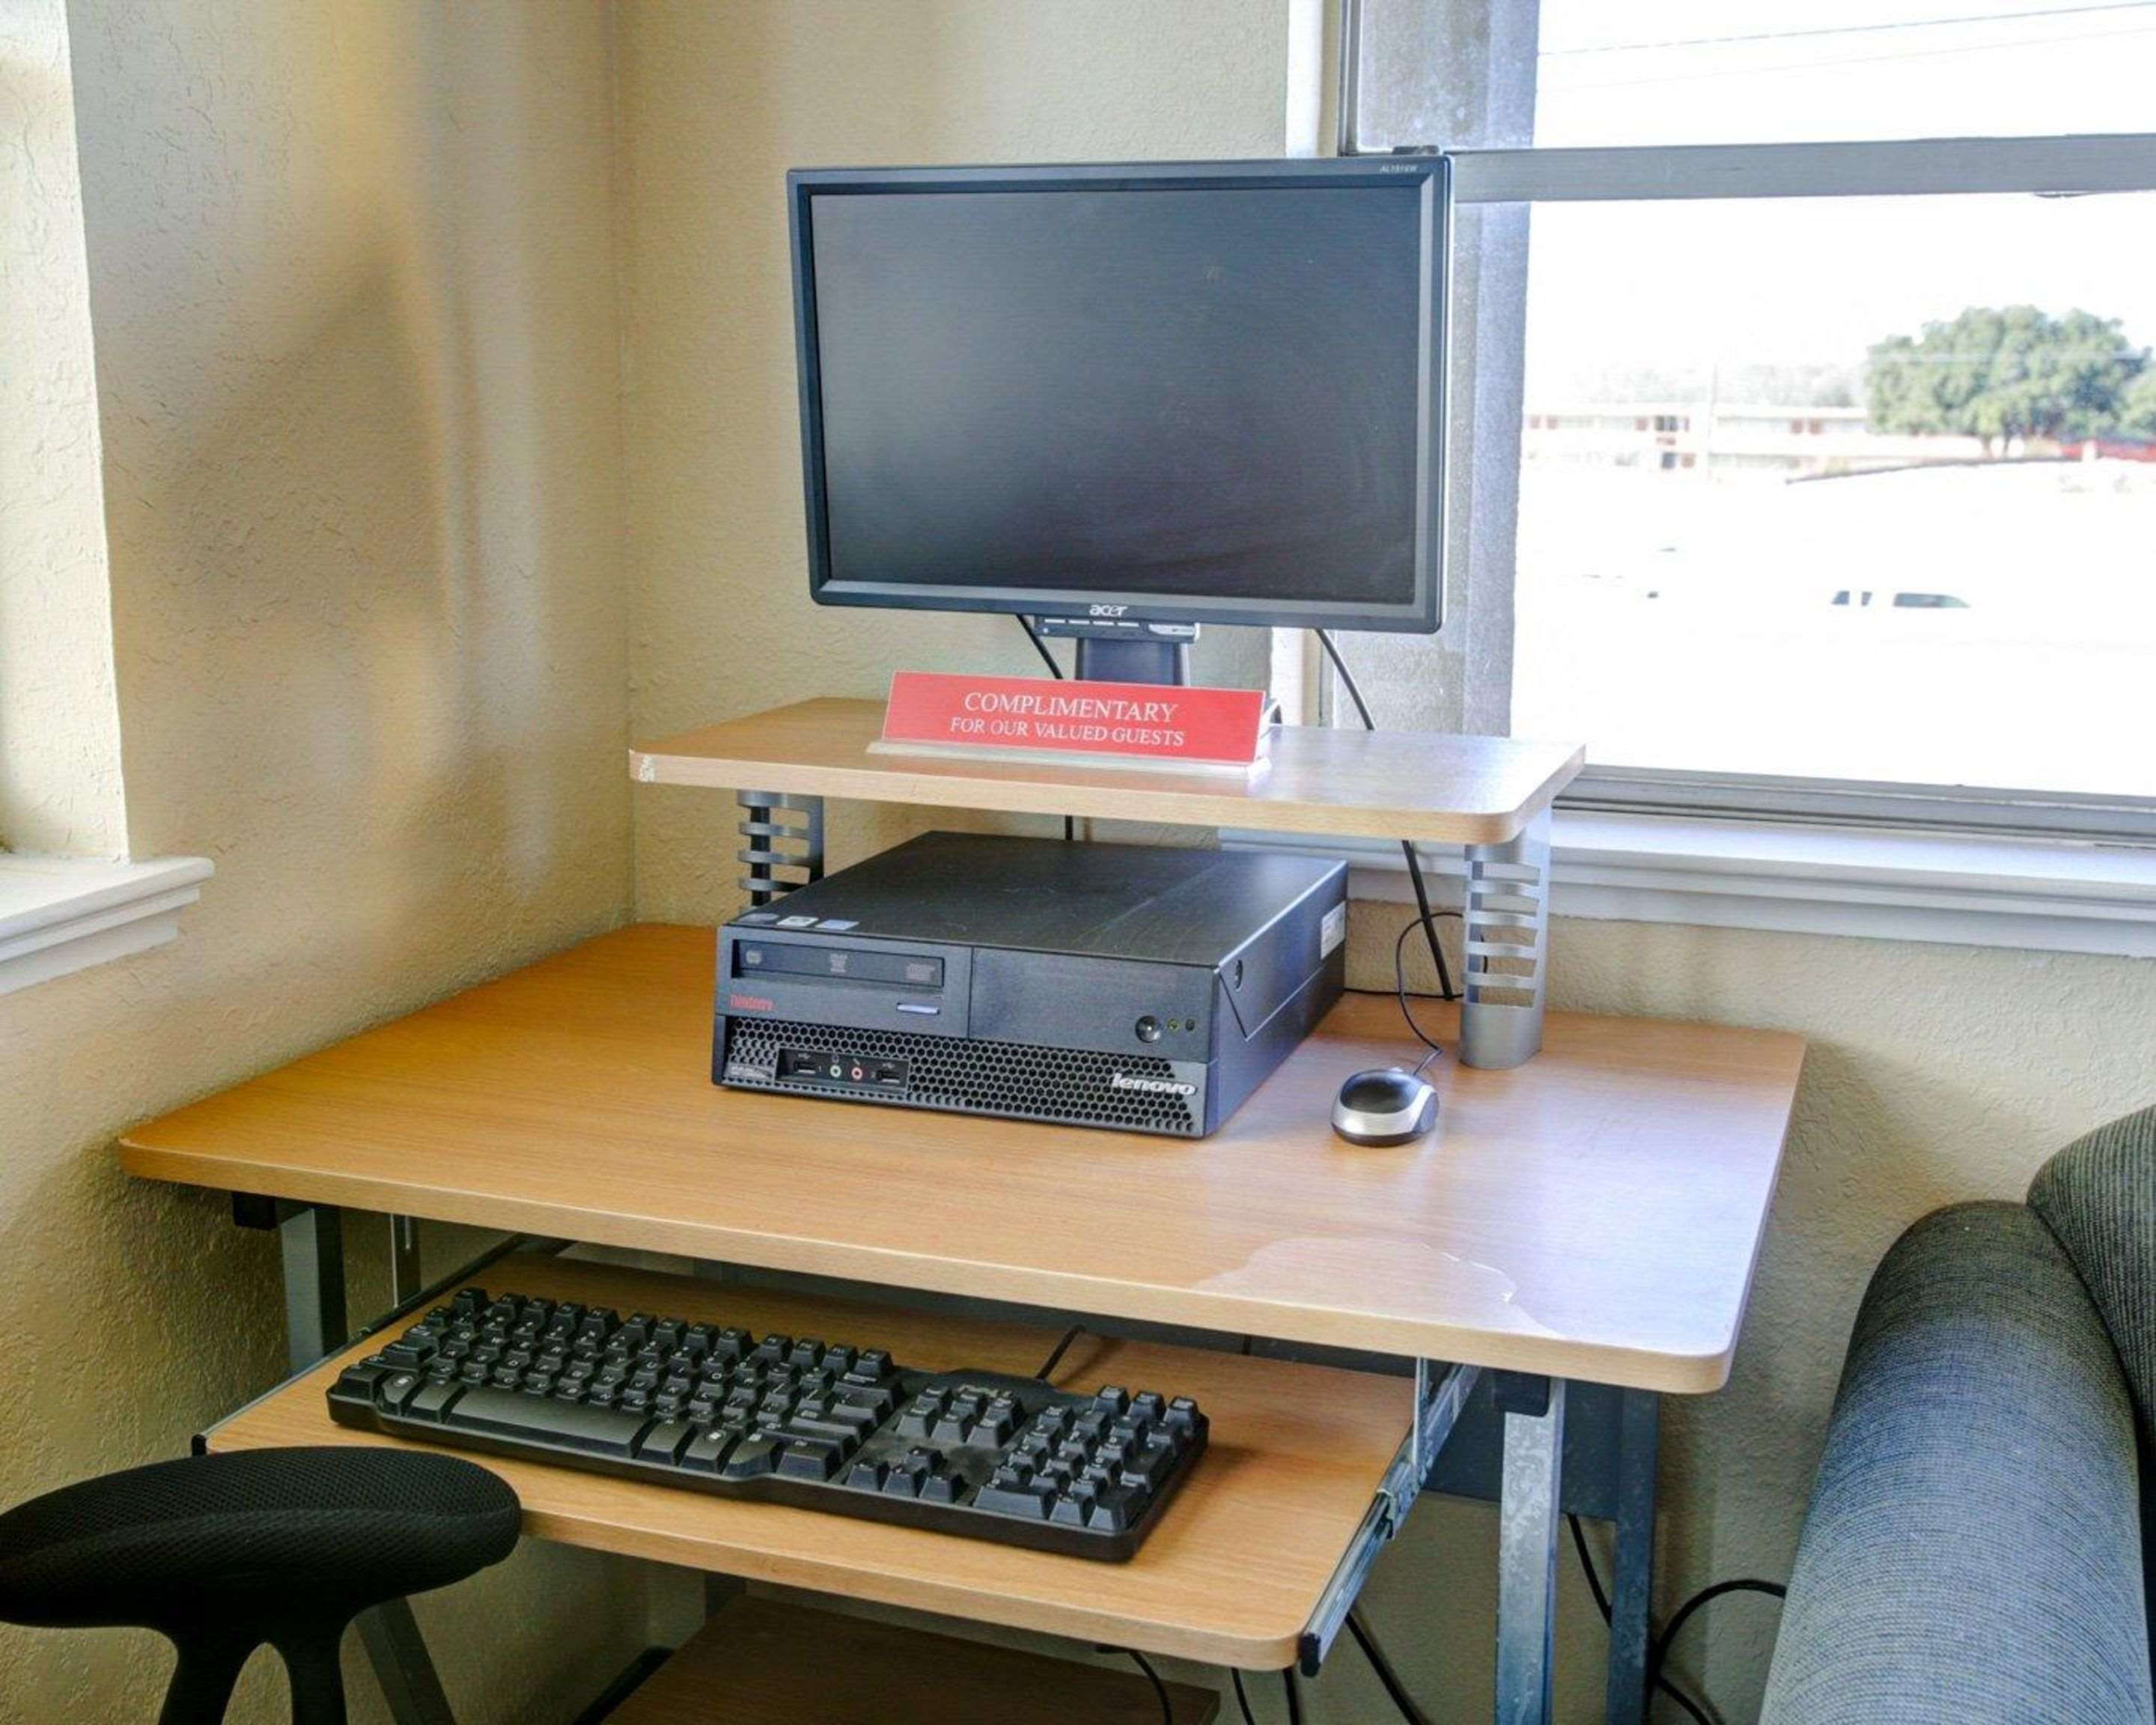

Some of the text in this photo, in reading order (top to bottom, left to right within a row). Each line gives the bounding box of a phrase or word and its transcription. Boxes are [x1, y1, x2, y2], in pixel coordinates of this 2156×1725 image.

[1089, 604, 1128, 617] acer
[963, 692, 1179, 722] COMPLIMENTARY
[949, 717, 1185, 746] FOR OUR VALUED GUESTS
[1112, 1072, 1196, 1095] lenovo
